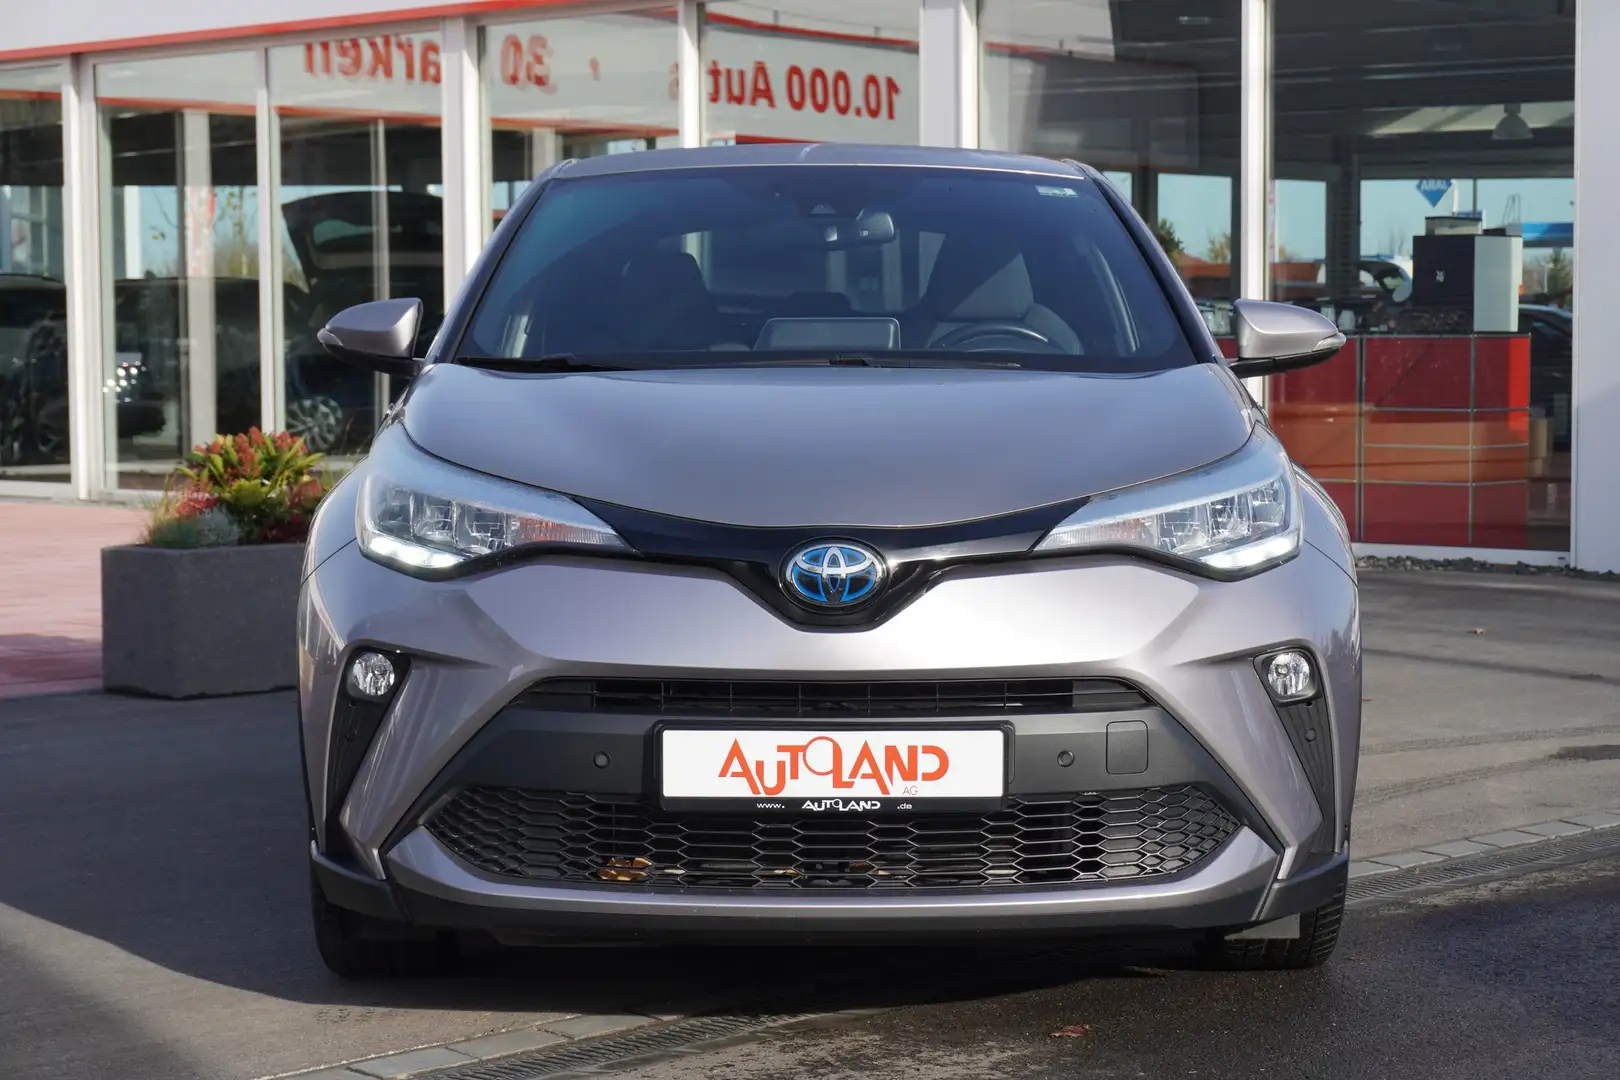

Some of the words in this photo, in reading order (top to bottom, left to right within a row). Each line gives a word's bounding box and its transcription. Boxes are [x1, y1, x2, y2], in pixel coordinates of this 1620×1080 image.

[718, 735, 950, 796] AUTOLAND
[902, 785, 919, 796] AG
[801, 798, 881, 812] AUTOLAND
